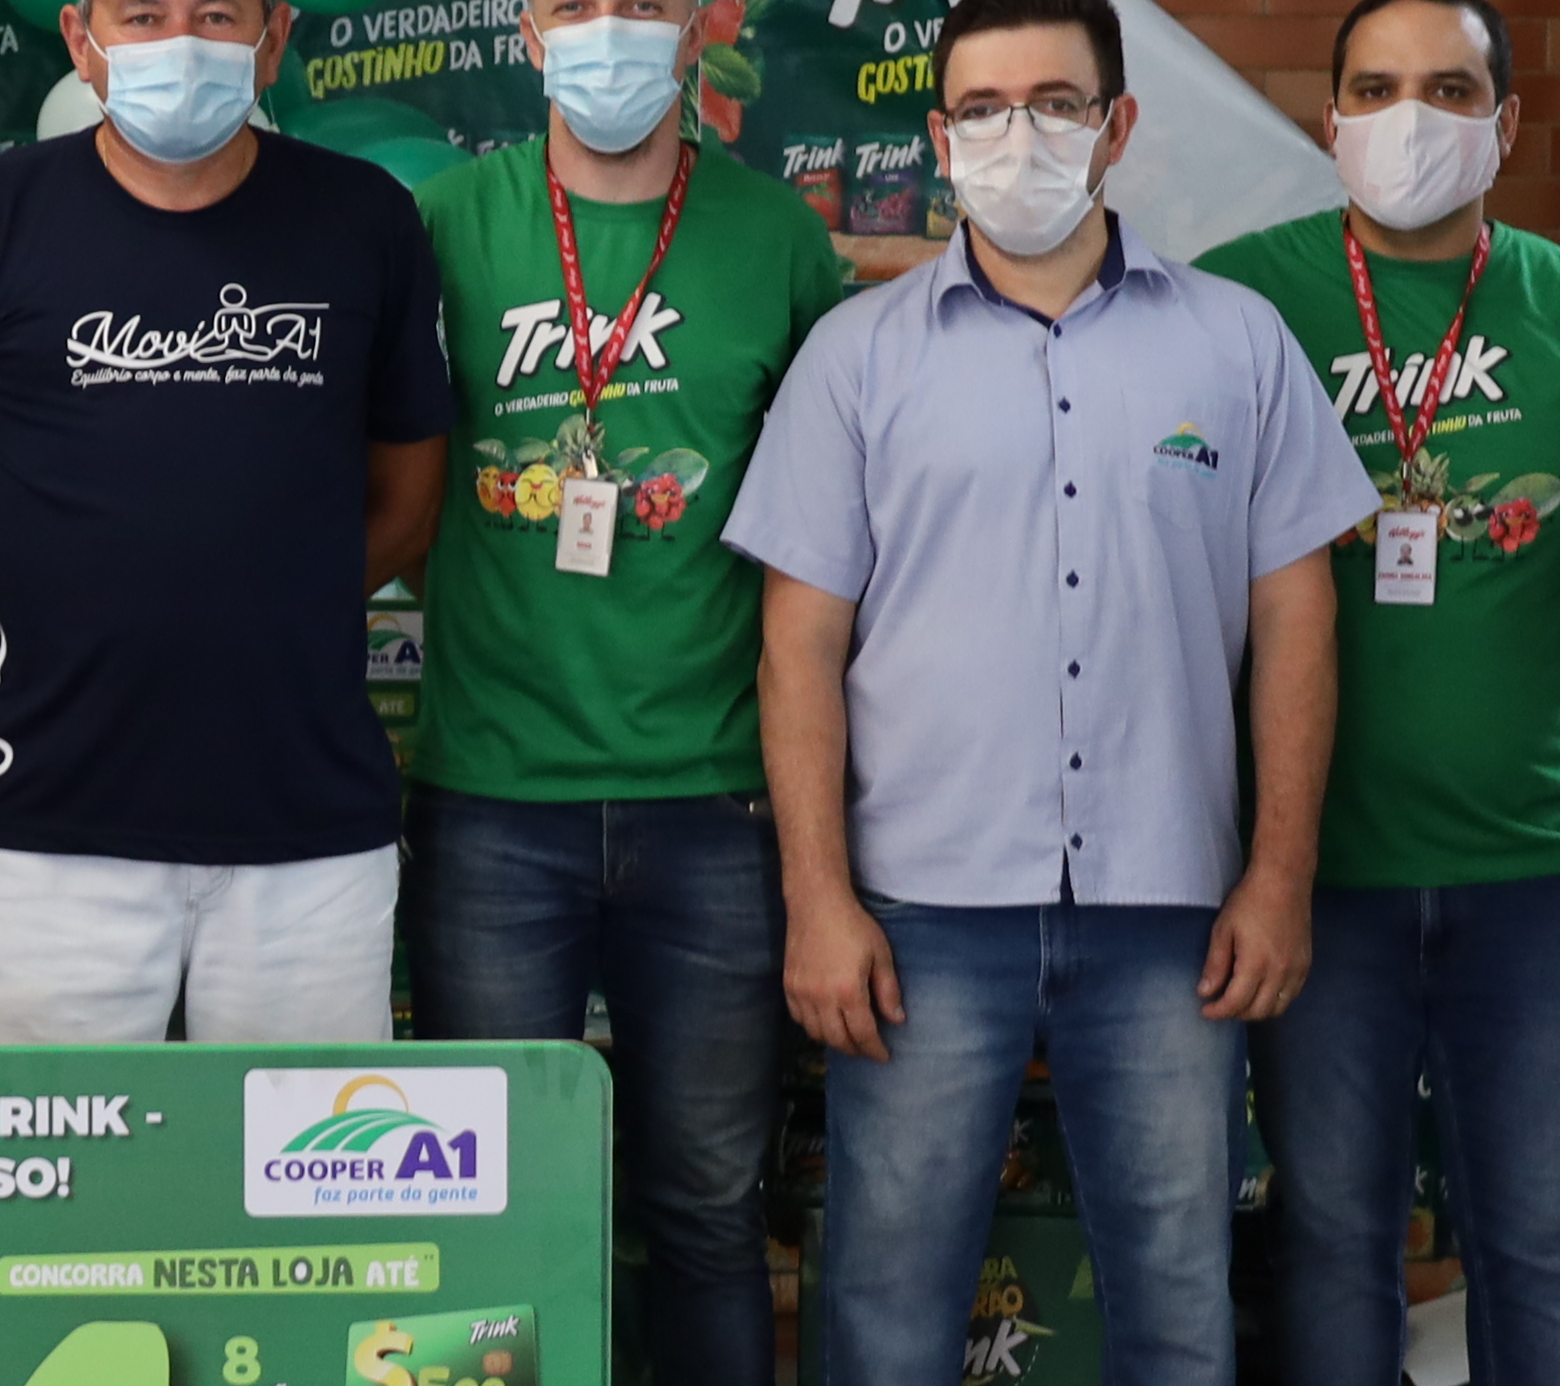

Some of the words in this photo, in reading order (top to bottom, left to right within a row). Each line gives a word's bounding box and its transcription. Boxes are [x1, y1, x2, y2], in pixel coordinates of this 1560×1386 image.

[330, 18, 353, 47] O
[884, 22, 906, 53] O
[450, 40, 483, 71] DA
[783, 138, 846, 179] Trink
[856, 135, 925, 179] Trink
[135, 369, 170, 385] corpo
[225, 365, 246, 385] faz
[248, 366, 280, 385] parte
[283, 365, 297, 382] da
[505, 392, 569, 414] VERDADEIRO
[627, 382, 641, 395] DA
[645, 378, 679, 393] FRUTA
[1468, 416, 1483, 427] DA
[1487, 408, 1522, 424] FRUTA
[1195, 446, 1219, 471] A1
[264, 1158, 385, 1182] COOPER
[394, 1128, 478, 1181] A1
[314, 1185, 341, 1206] faz
[347, 1185, 394, 1206] parte
[400, 1184, 422, 1202] da
[428, 1185, 478, 1205] gente
[9, 1261, 144, 1288] CONCORRA
[153, 1257, 260, 1289] NESTA
[272, 1255, 355, 1287] LOJA
[469, 1314, 520, 1345] Trink
[222, 1335, 261, 1386] 8
